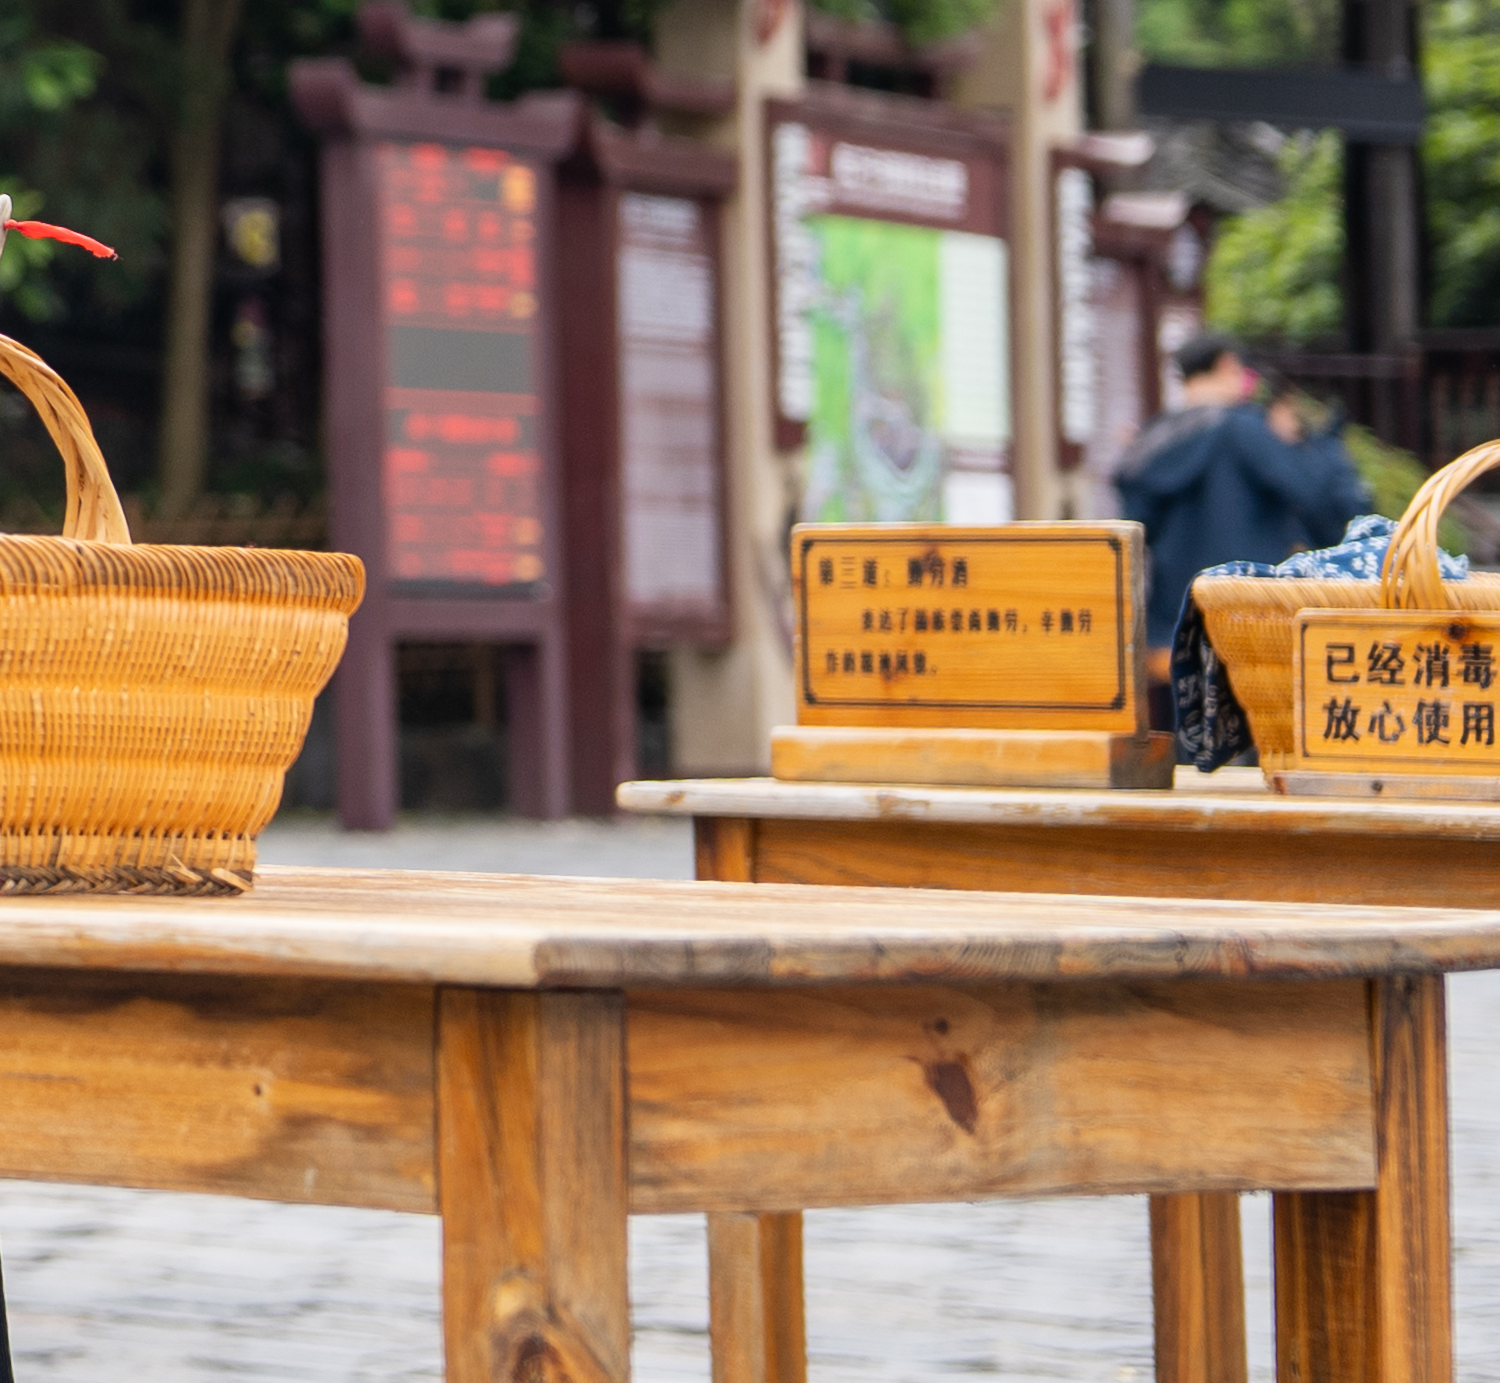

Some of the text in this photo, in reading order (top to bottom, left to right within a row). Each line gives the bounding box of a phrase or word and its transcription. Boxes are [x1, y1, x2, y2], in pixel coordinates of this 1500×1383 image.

[1325, 641, 1498, 689] 已经消毒
[1322, 695, 1495, 745] 放心使用
